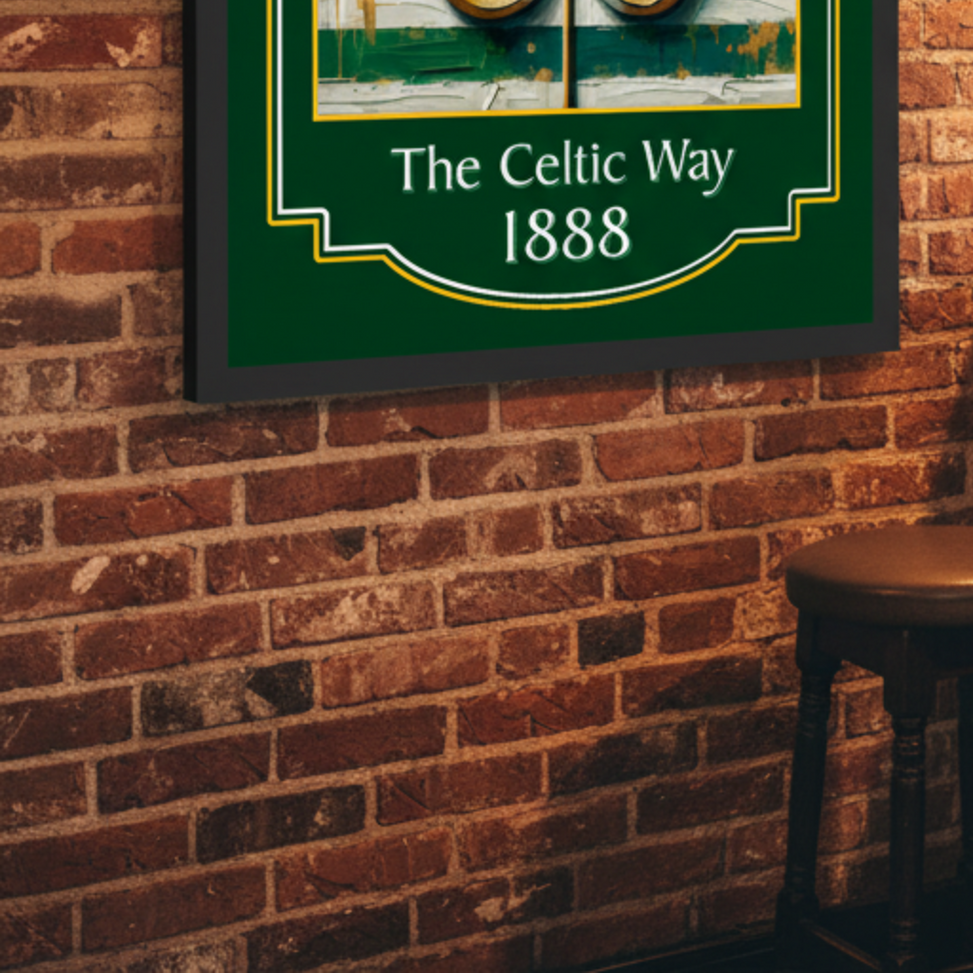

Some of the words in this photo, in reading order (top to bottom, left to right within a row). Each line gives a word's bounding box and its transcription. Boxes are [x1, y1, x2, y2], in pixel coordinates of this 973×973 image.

[390, 144, 481, 192] The
[500, 138, 627, 188] Celtic
[642, 137, 736, 197] Way
[505, 205, 632, 264] 1888
